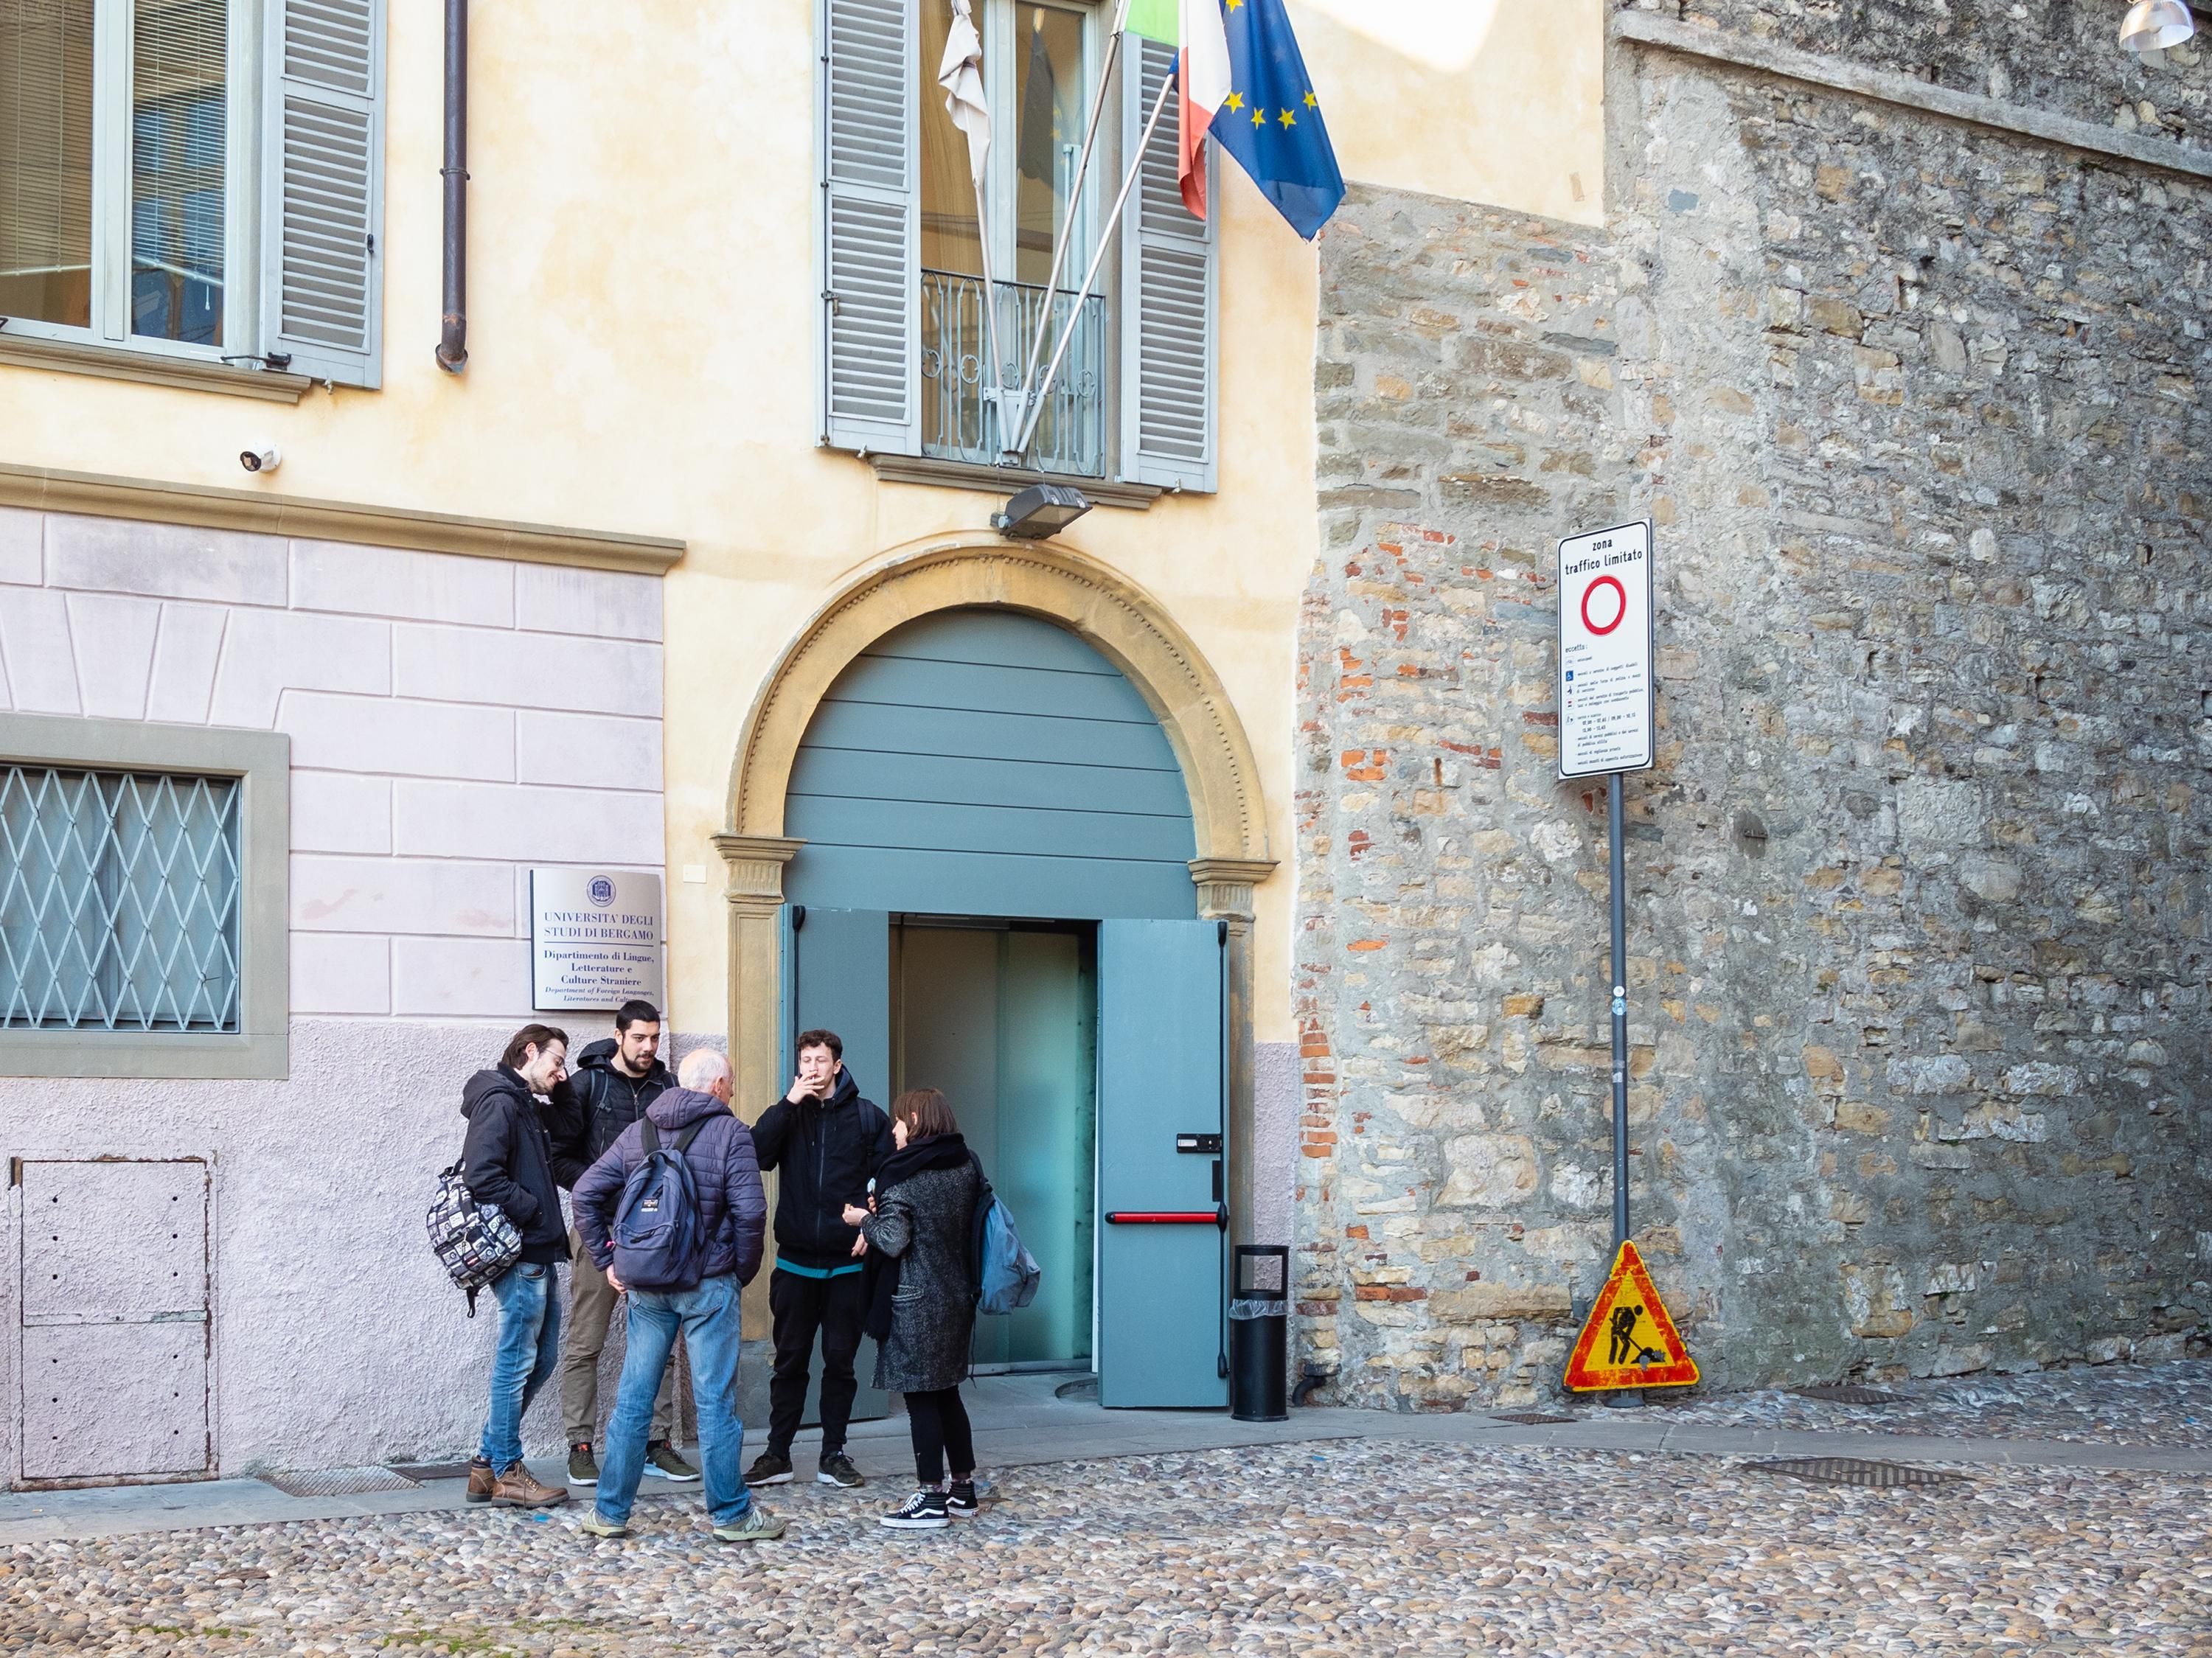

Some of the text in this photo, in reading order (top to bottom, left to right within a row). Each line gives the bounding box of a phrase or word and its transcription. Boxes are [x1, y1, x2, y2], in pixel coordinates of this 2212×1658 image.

[1593, 539, 1613, 551] zona
[1565, 548, 1642, 575] traffico limitato
[544, 912, 653, 926] UNIVERSITA' DEGLI
[544, 927, 654, 941] STUDI DI BERGAMO
[544, 950, 654, 963] Dipartimento di Lingue,
[571, 962, 625, 973] Letterature
[561, 975, 641, 986] Culture Straniere
[545, 986, 585, 995] Department
[588, 987, 595, 995] of
[596, 987, 621, 995] Foreign
